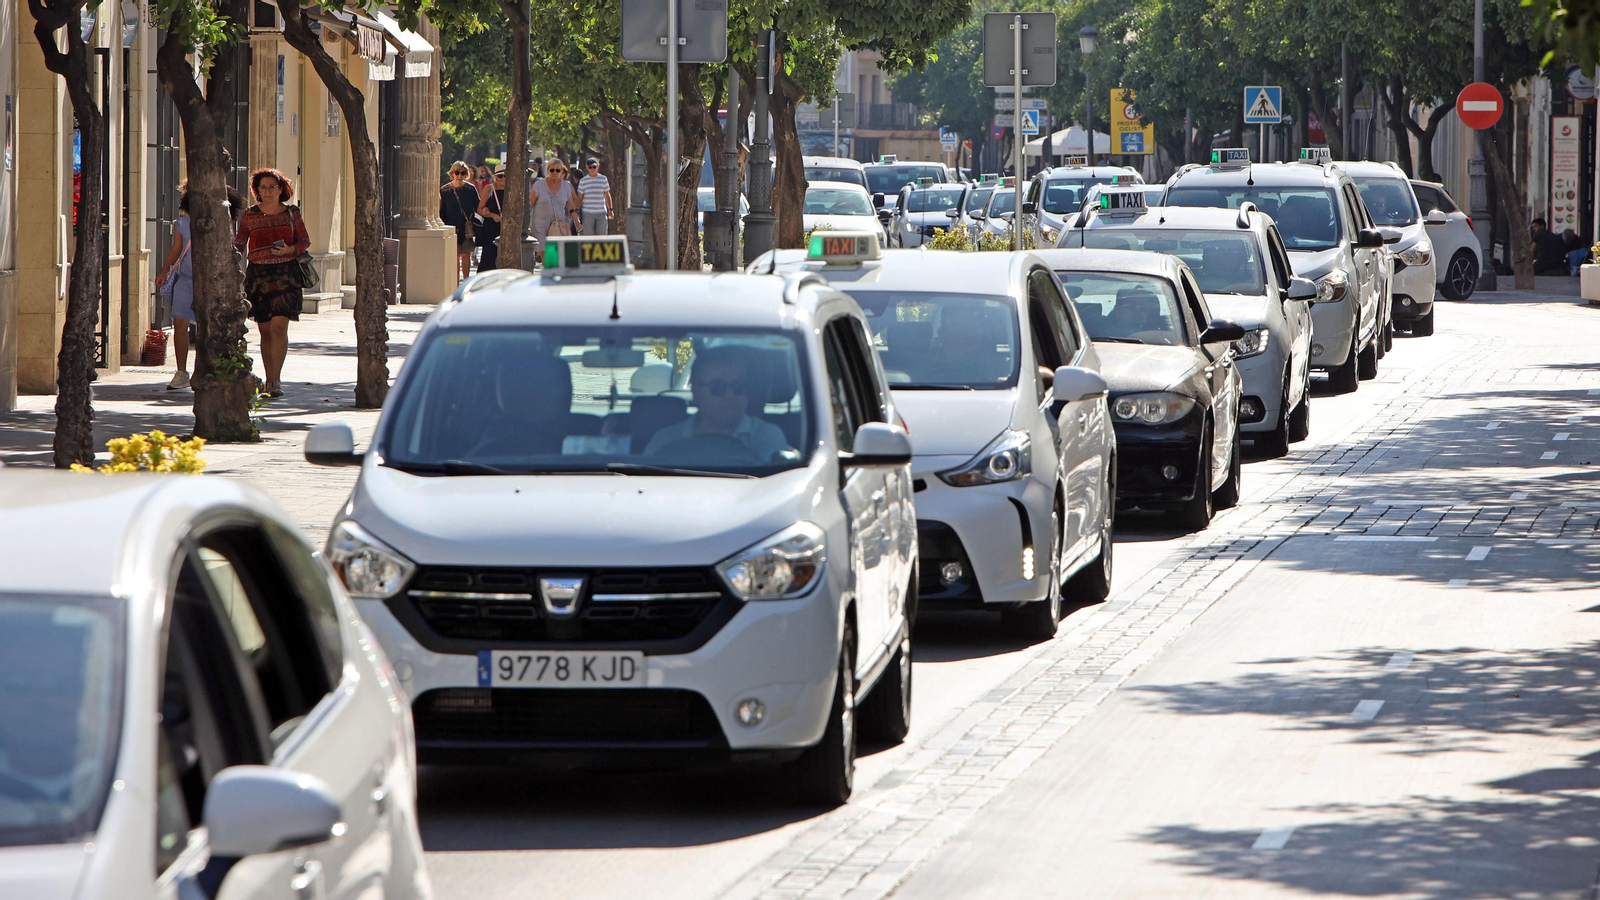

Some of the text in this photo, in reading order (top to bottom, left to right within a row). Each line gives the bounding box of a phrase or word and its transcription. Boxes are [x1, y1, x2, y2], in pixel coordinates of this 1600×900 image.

[1229, 151, 1247, 159] TAXI
[1315, 150, 1329, 158] TAXI
[1121, 193, 1142, 208] TAXI
[582, 243, 621, 261] TAXI
[825, 238, 855, 255] TAXI
[498, 655, 570, 681] 9778
[582, 655, 635, 681] KJD
